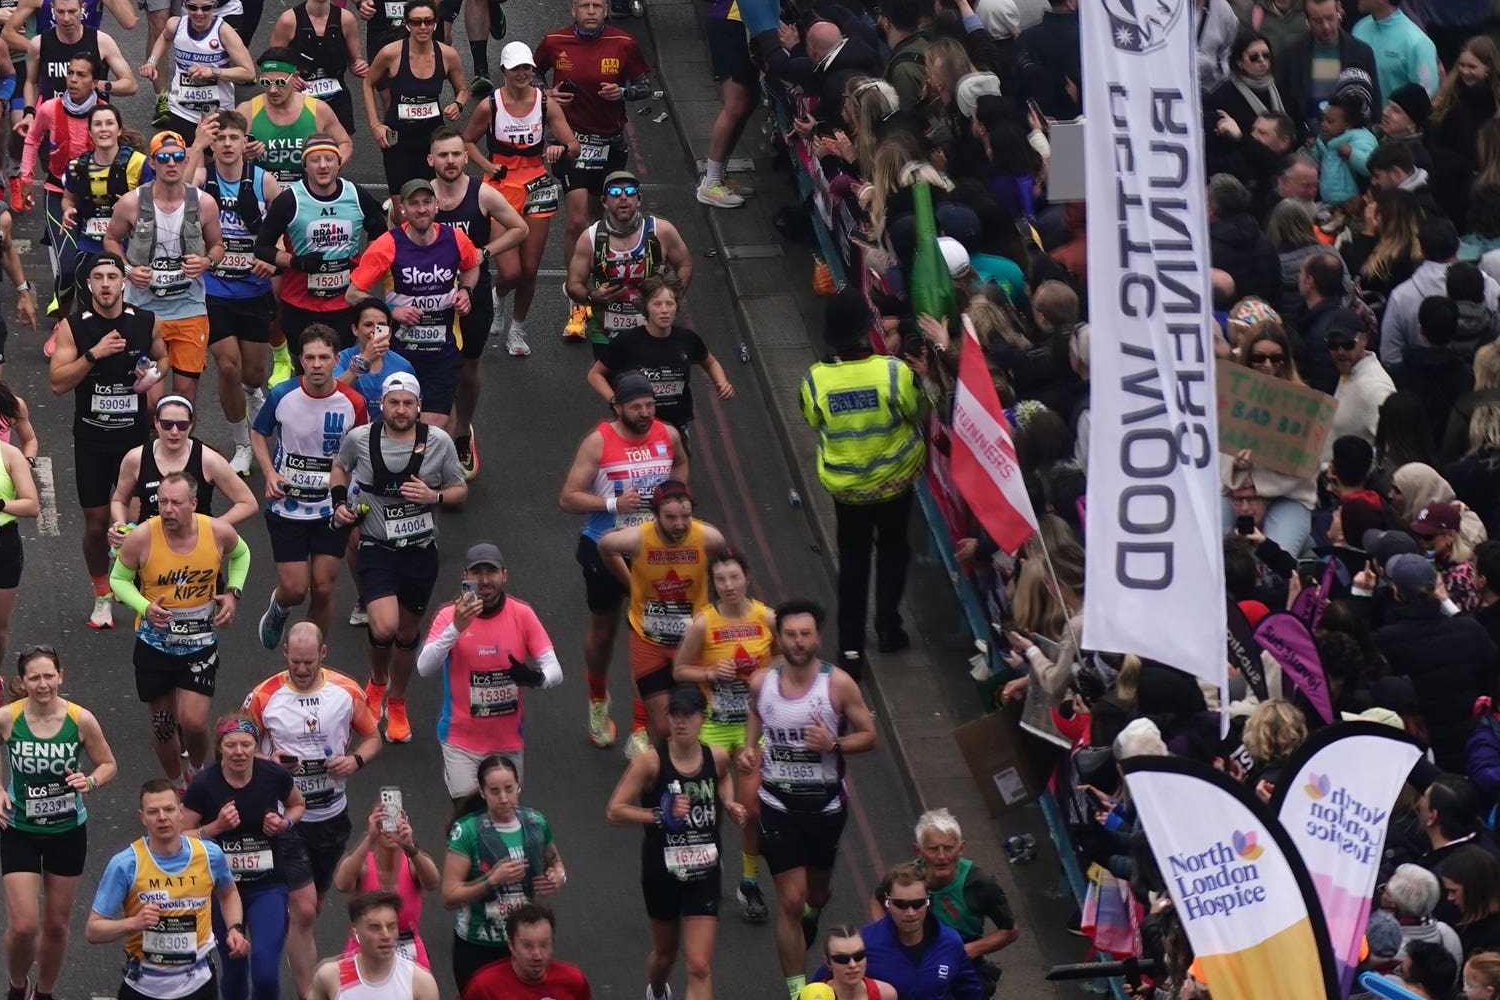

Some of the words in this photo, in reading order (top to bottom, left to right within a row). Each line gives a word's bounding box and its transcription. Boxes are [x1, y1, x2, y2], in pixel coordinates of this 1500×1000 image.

[193, 51, 223, 62] SHIELDS
[184, 90, 213, 100] 44505
[405, 107, 433, 117] 15834
[268, 138, 303, 149] KYLE
[509, 134, 534, 145] TAS
[259, 149, 303, 164] NSPC
[320, 206, 337, 217] AL
[313, 223, 344, 238] BRAIN
[311, 231, 349, 244] TUMOUR
[222, 255, 248, 265] 2392
[401, 264, 453, 285] Stroke
[315, 276, 344, 287] 15201
[411, 283, 443, 292] Association
[410, 297, 442, 310] ANDY
[613, 317, 638, 327] 9734
[407, 328, 440, 339] 48390
[99, 399, 131, 409] 59094
[829, 394, 879, 414] POLICE
[1232, 400, 1272, 425] BAD
[955, 402, 1015, 482] RUNNERS
[625, 448, 652, 463] TOM
[291, 474, 323, 484] 43477
[394, 518, 426, 533] 44004
[157, 565, 213, 586] WHIZZ
[299, 697, 320, 706] TIM
[478, 688, 512, 703] 15395
[11, 741, 79, 758] JENNY
[11, 757, 78, 775] NSPCC
[232, 856, 261, 868] 8157
[672, 849, 711, 864] 16720
[1166, 841, 1237, 877] North
[149, 875, 197, 889] MATT
[1174, 860, 1260, 900] London
[139, 892, 167, 903] Cystic
[1181, 882, 1267, 921] Hospice
